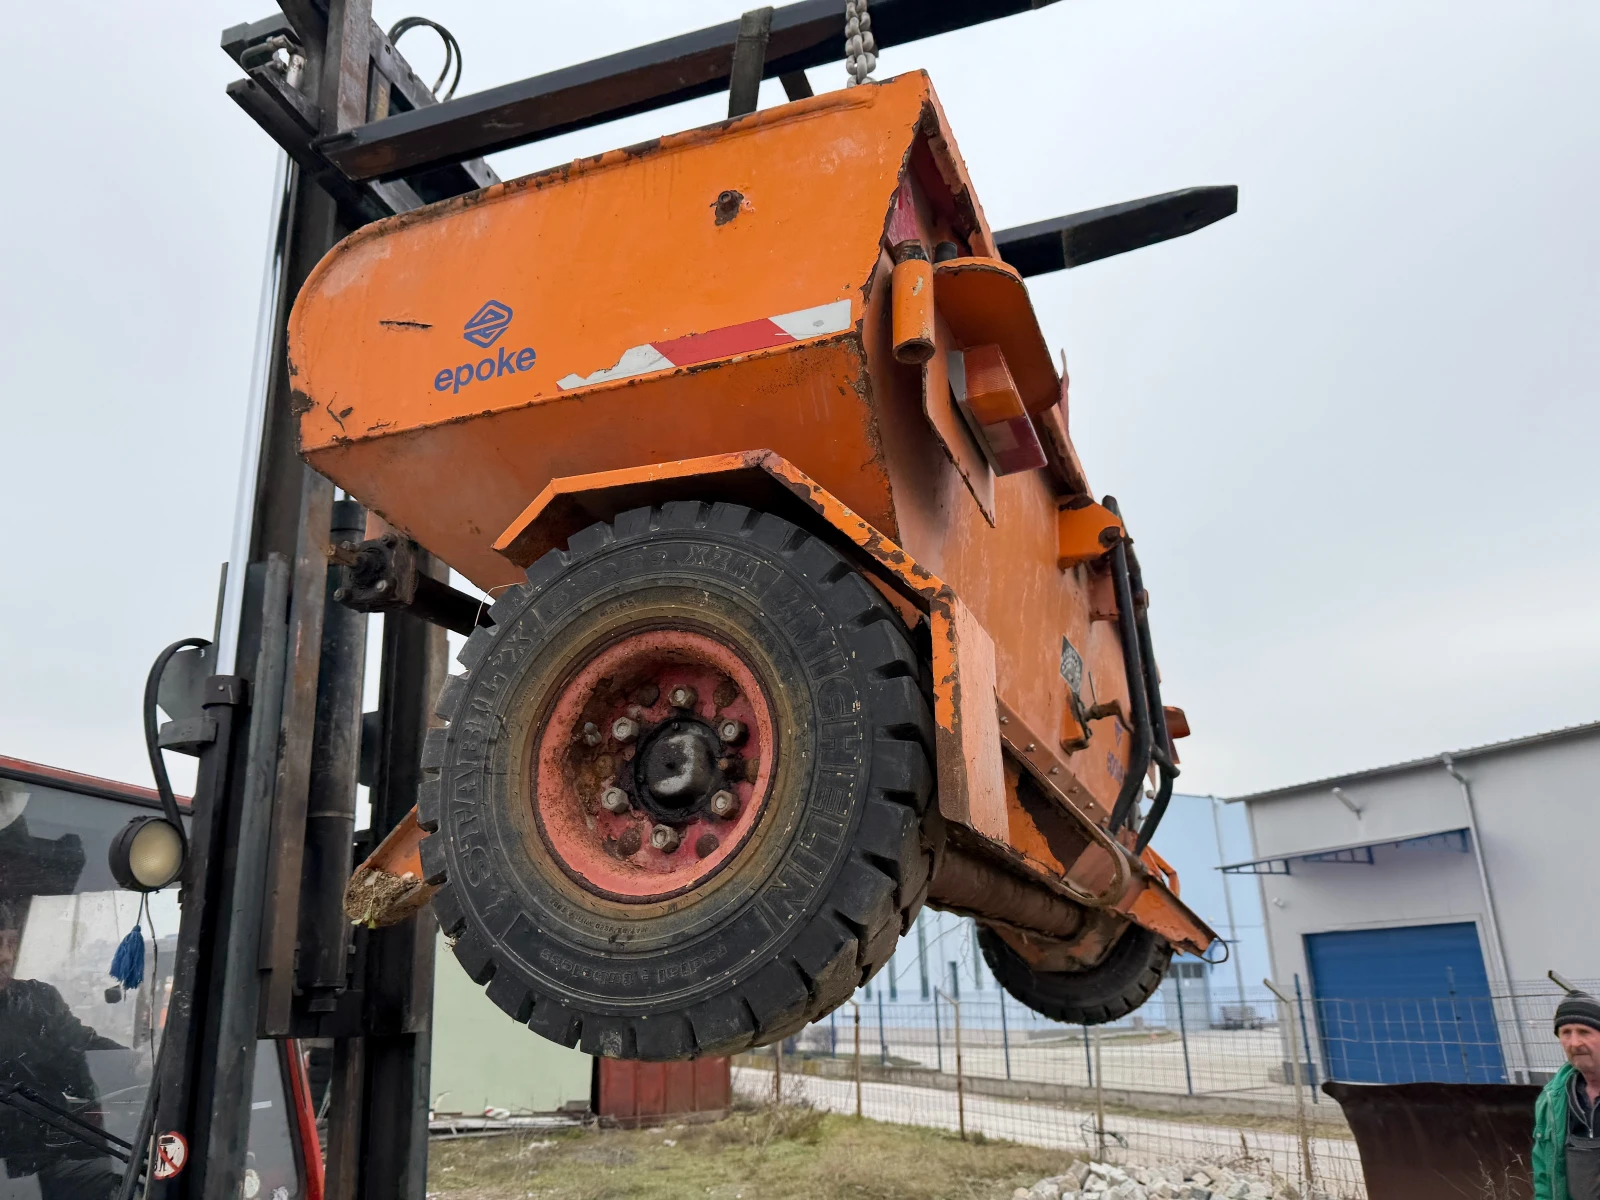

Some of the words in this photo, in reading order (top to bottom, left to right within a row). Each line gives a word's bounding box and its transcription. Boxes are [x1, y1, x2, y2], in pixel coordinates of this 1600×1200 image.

[434, 347, 536, 394] epoke
[761, 603, 860, 928] MICHELIN
[539, 947, 634, 987] tubeless
[657, 943, 728, 984] radial
